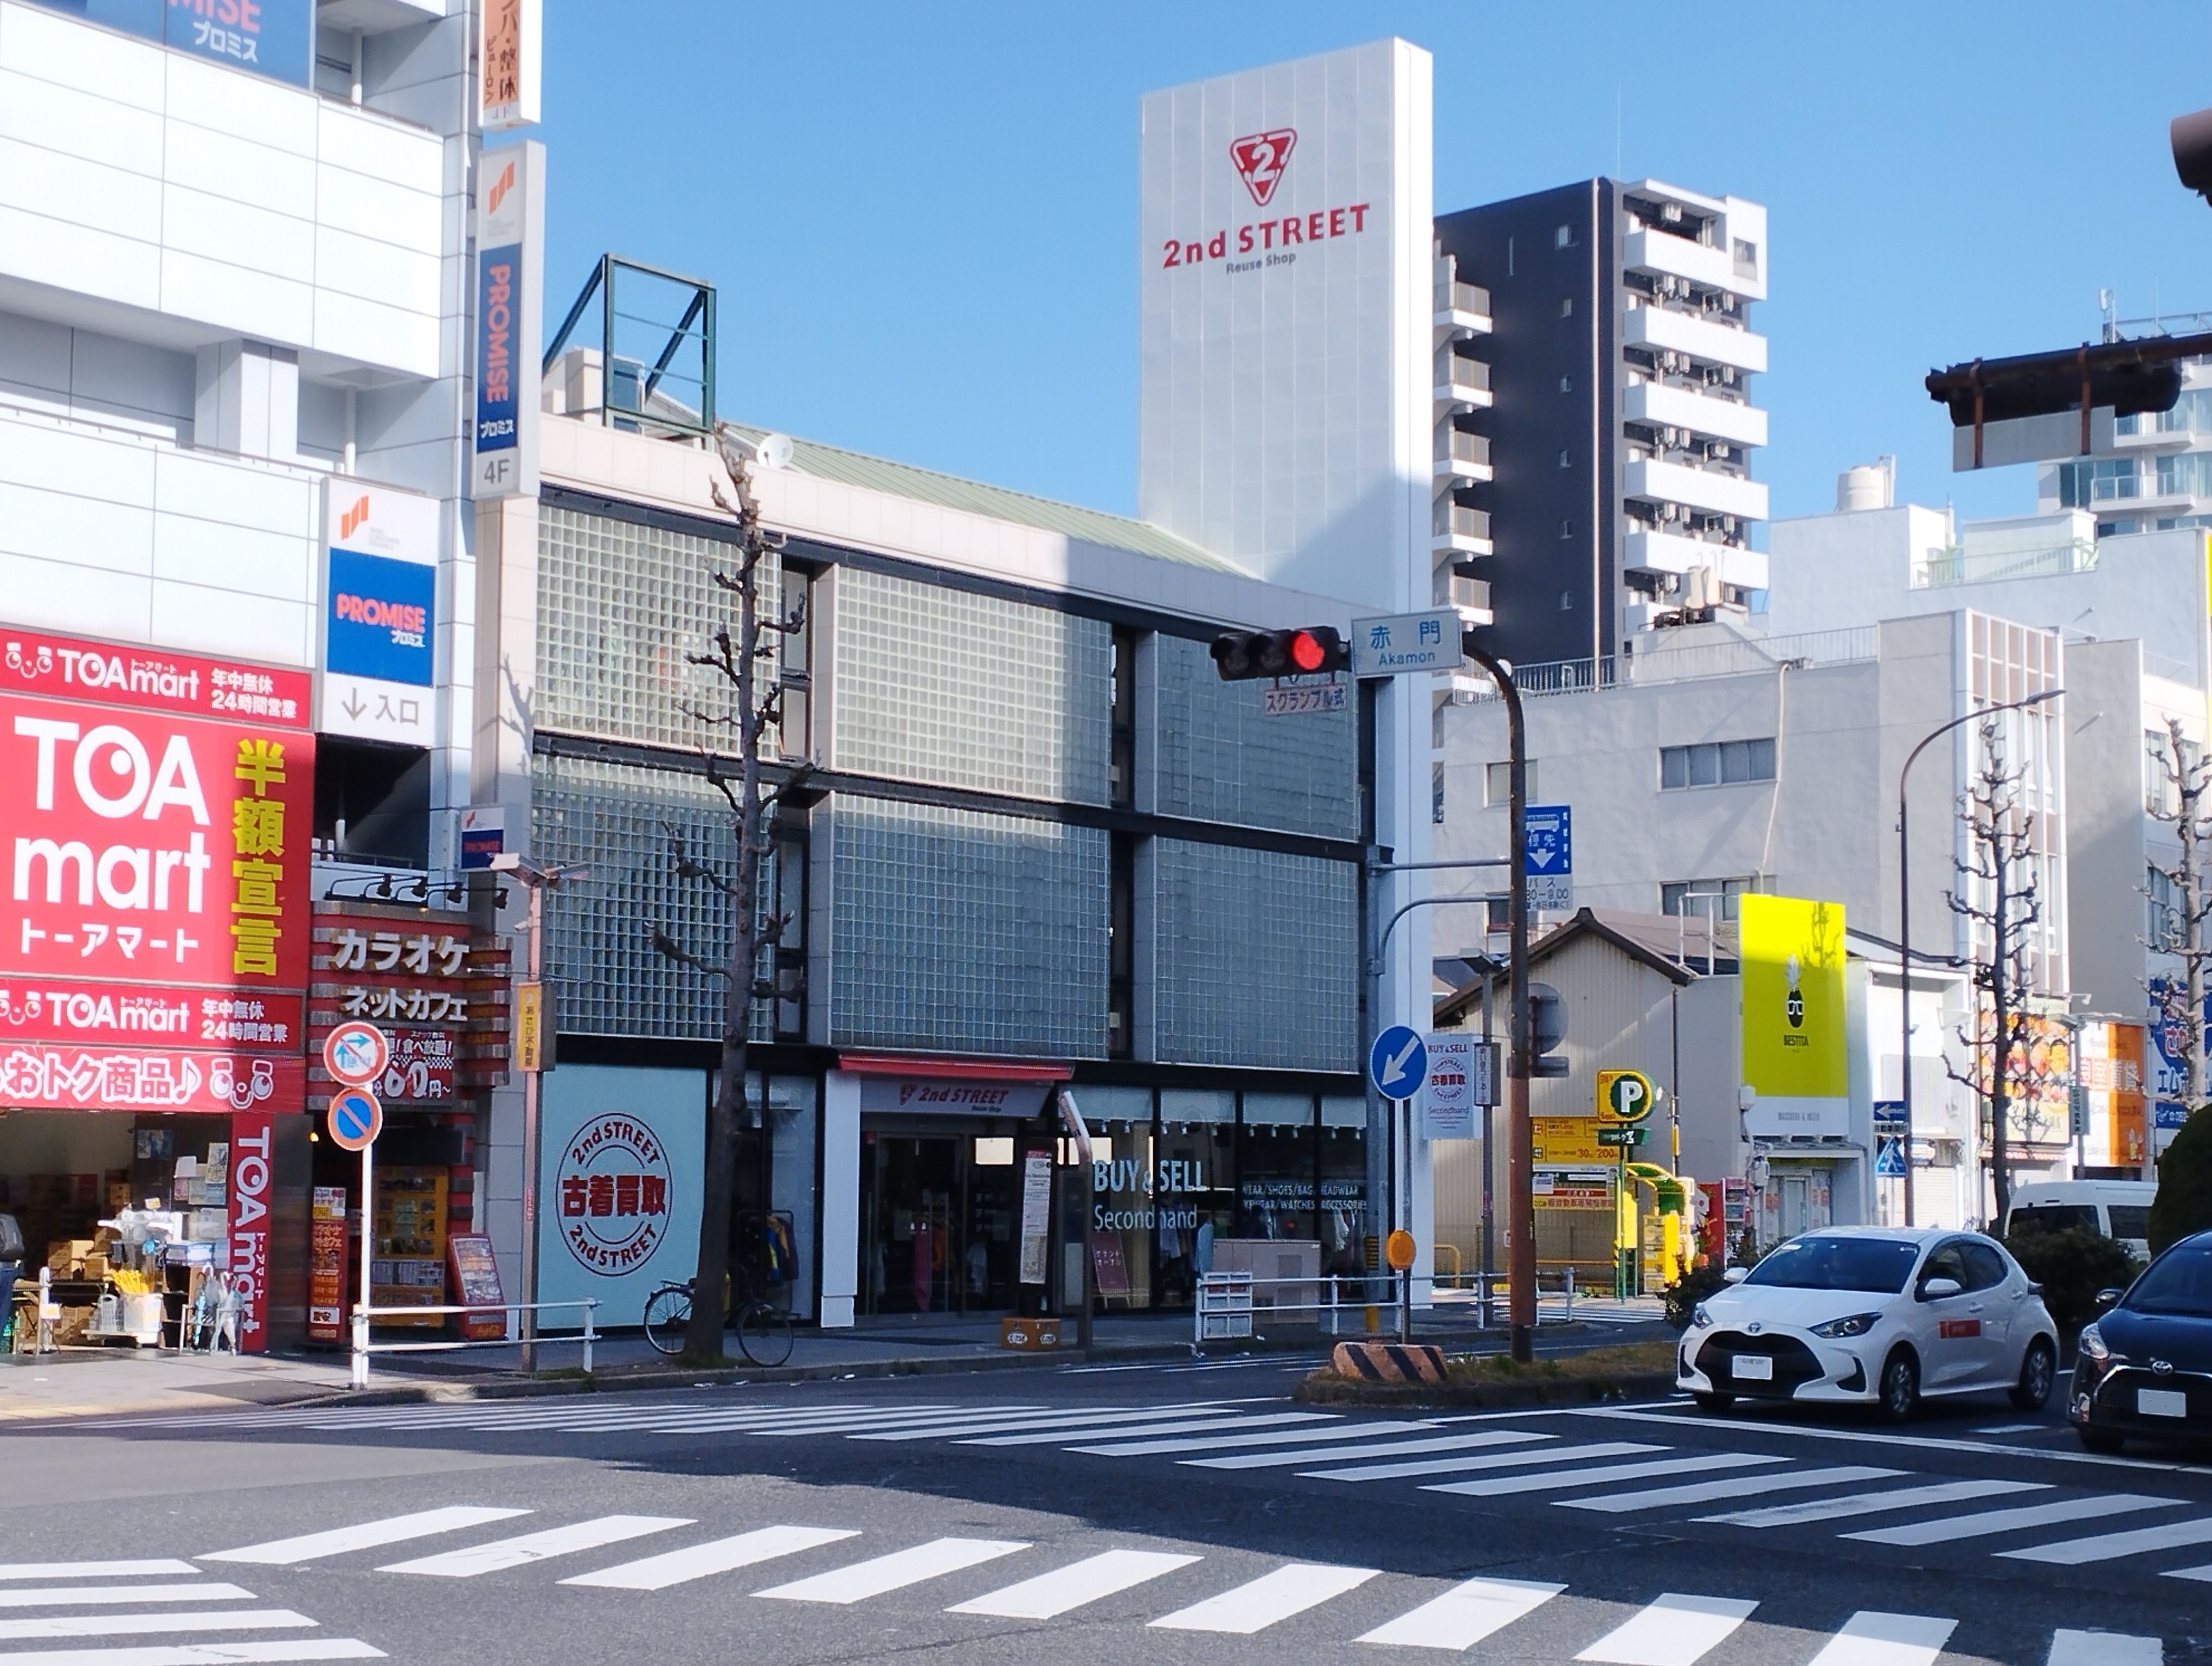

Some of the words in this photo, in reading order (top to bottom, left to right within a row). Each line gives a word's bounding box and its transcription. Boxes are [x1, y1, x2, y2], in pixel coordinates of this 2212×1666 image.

[193, 21, 259, 63] プロミス
[1162, 230, 1226, 269] 2nd
[1239, 203, 1369, 253] STREET
[1226, 259, 1263, 275] Reuse
[1266, 253, 1296, 267] Shop
[486, 264, 511, 403] PROMISE
[480, 419, 514, 439] プロミス
[484, 459, 510, 484] 4F
[336, 593, 426, 633] PROMISE
[391, 629, 426, 648] プロミス
[1370, 620, 1441, 650] 赤門
[1379, 652, 1436, 666] Akamon
[211, 668, 274, 694] 年中無休
[211, 690, 297, 719] 24時間営業
[375, 694, 419, 726] 入口
[14, 716, 211, 826] TOA
[14, 831, 211, 913] mart
[230, 739, 286, 976] 半額宣言
[21, 918, 199, 964] トーアマート
[331, 928, 470, 976] カラオケ
[201, 999, 265, 1020] 年中無休
[340, 986, 469, 1022] ネットカフェ
[201, 1020, 288, 1044] 24時間営業
[918, 1087, 948, 1102] 2nd
[951, 1087, 1009, 1104] STREET
[1621, 1081, 1643, 1113] P
[572, 1126, 603, 1165] 2nd
[603, 1121, 660, 1164] STREET
[1094, 1159, 1140, 1192] BUY
[1160, 1160, 1208, 1192] SELL
[562, 1175, 666, 1217] 古着買取
[569, 1223, 599, 1262] 2nd
[599, 1223, 657, 1267] STREET
